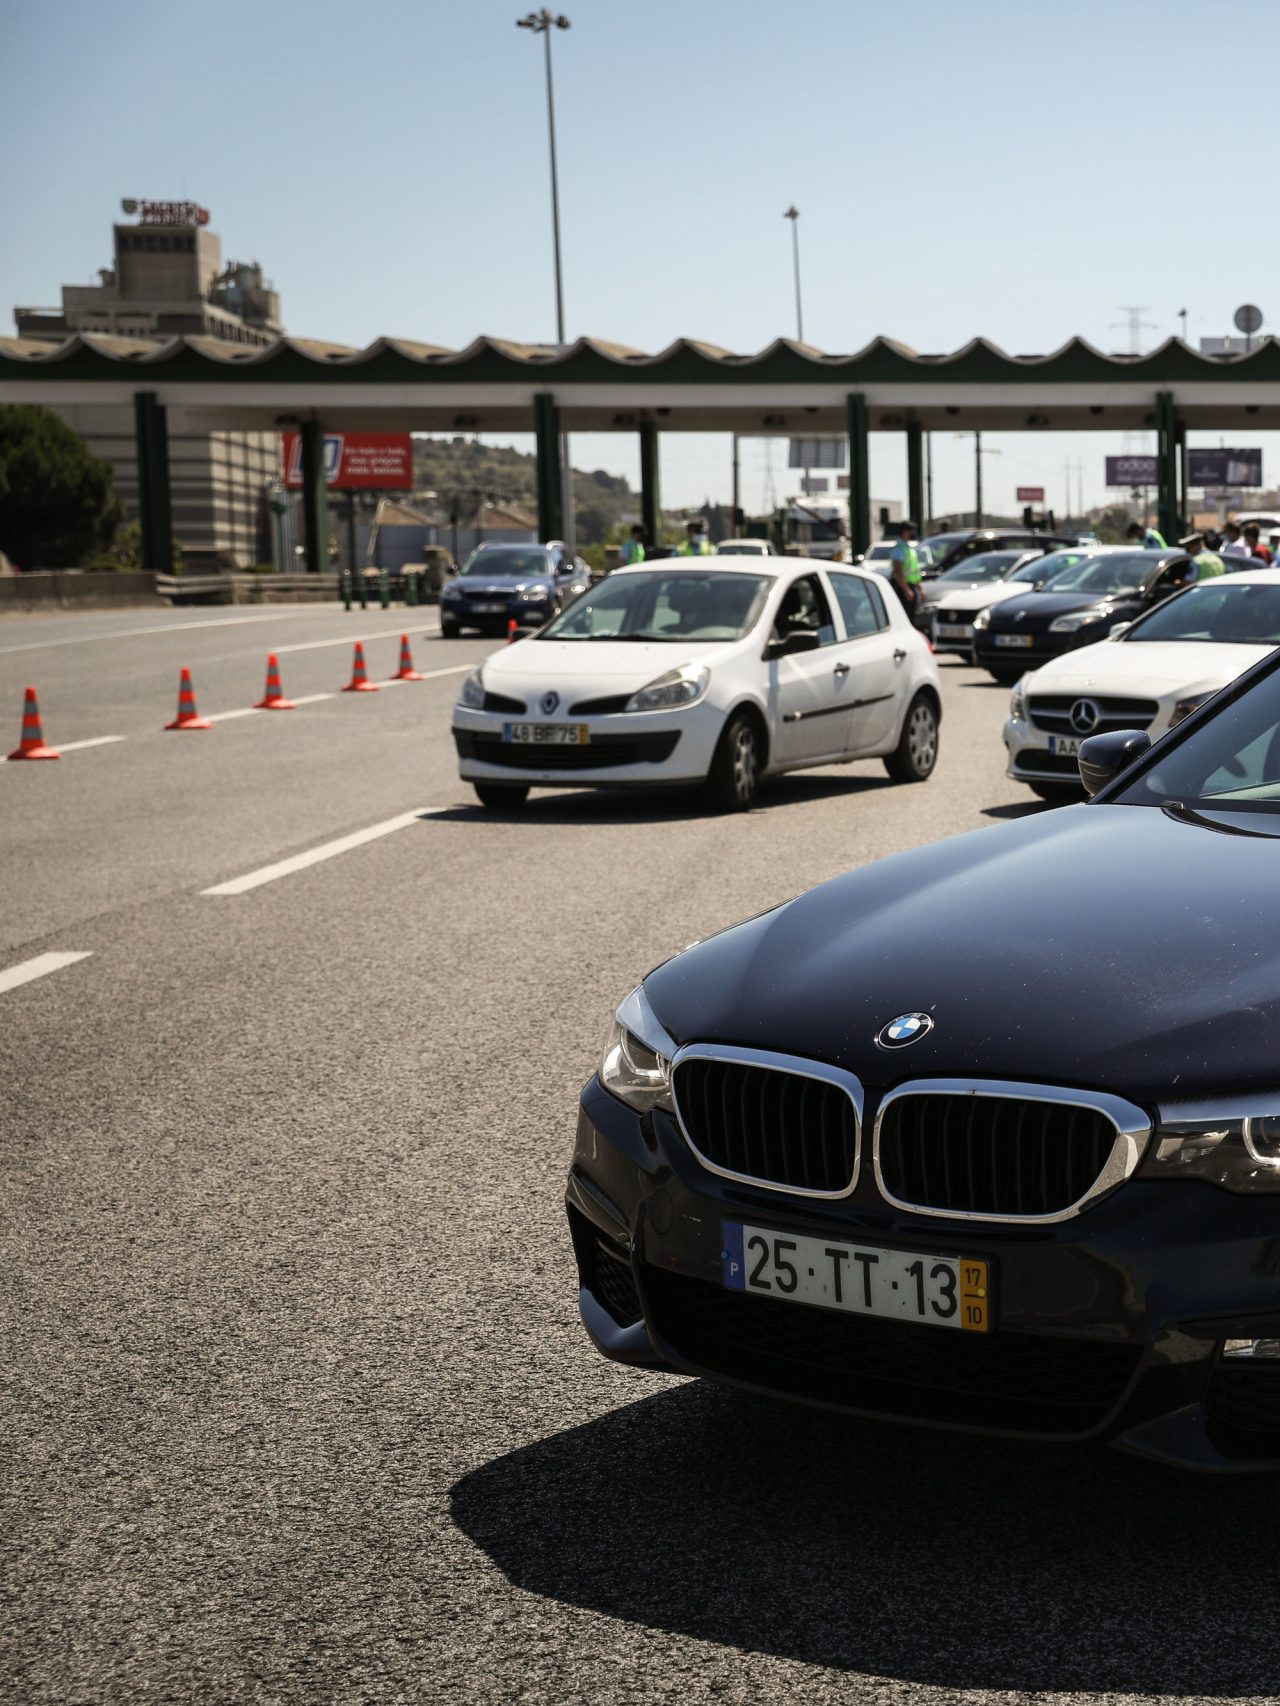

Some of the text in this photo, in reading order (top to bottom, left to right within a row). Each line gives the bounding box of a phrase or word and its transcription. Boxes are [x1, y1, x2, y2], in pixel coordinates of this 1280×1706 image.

[730, 1262, 739, 1276] P
[965, 1267, 980, 1287] 17
[966, 1305, 982, 1325] 10
